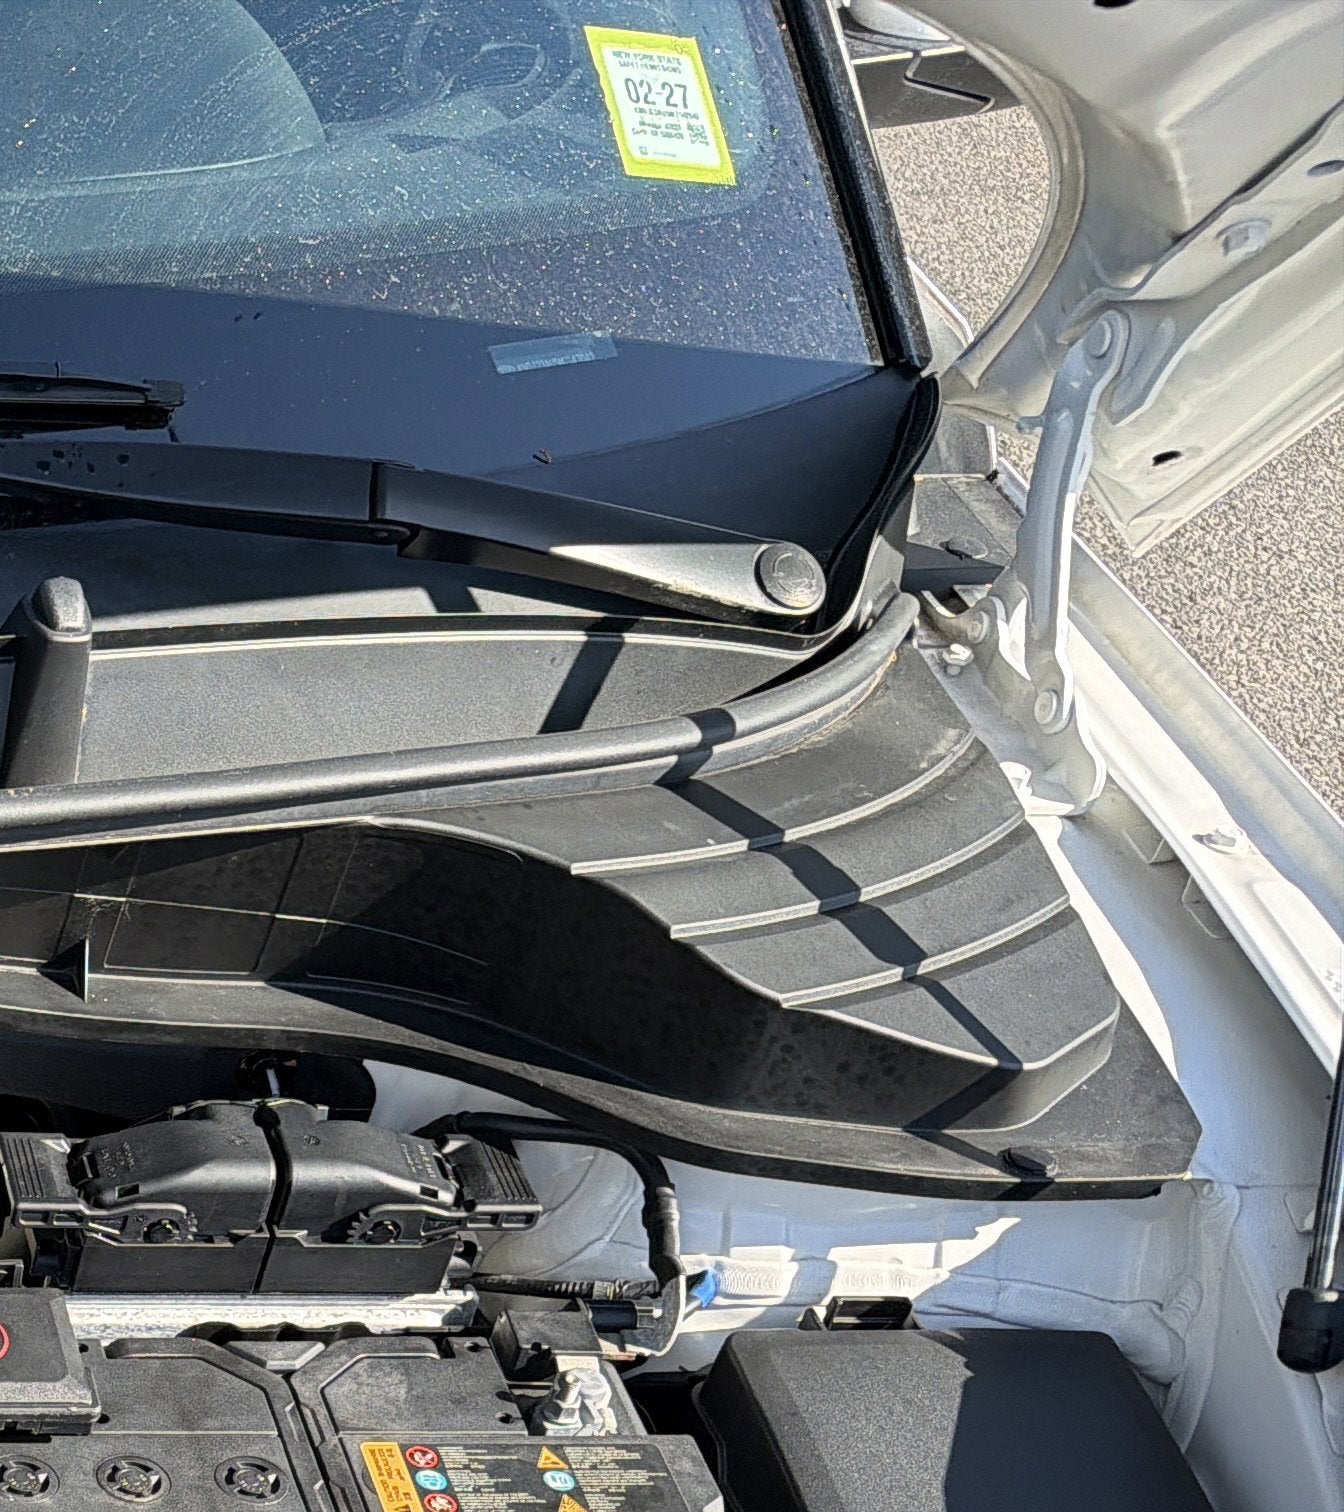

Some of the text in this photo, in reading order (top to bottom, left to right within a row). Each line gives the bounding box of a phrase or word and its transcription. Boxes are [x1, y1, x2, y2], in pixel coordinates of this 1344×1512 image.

[633, 52, 654, 61] YORK
[657, 54, 682, 66] STATE
[624, 77, 689, 109] 02-27
